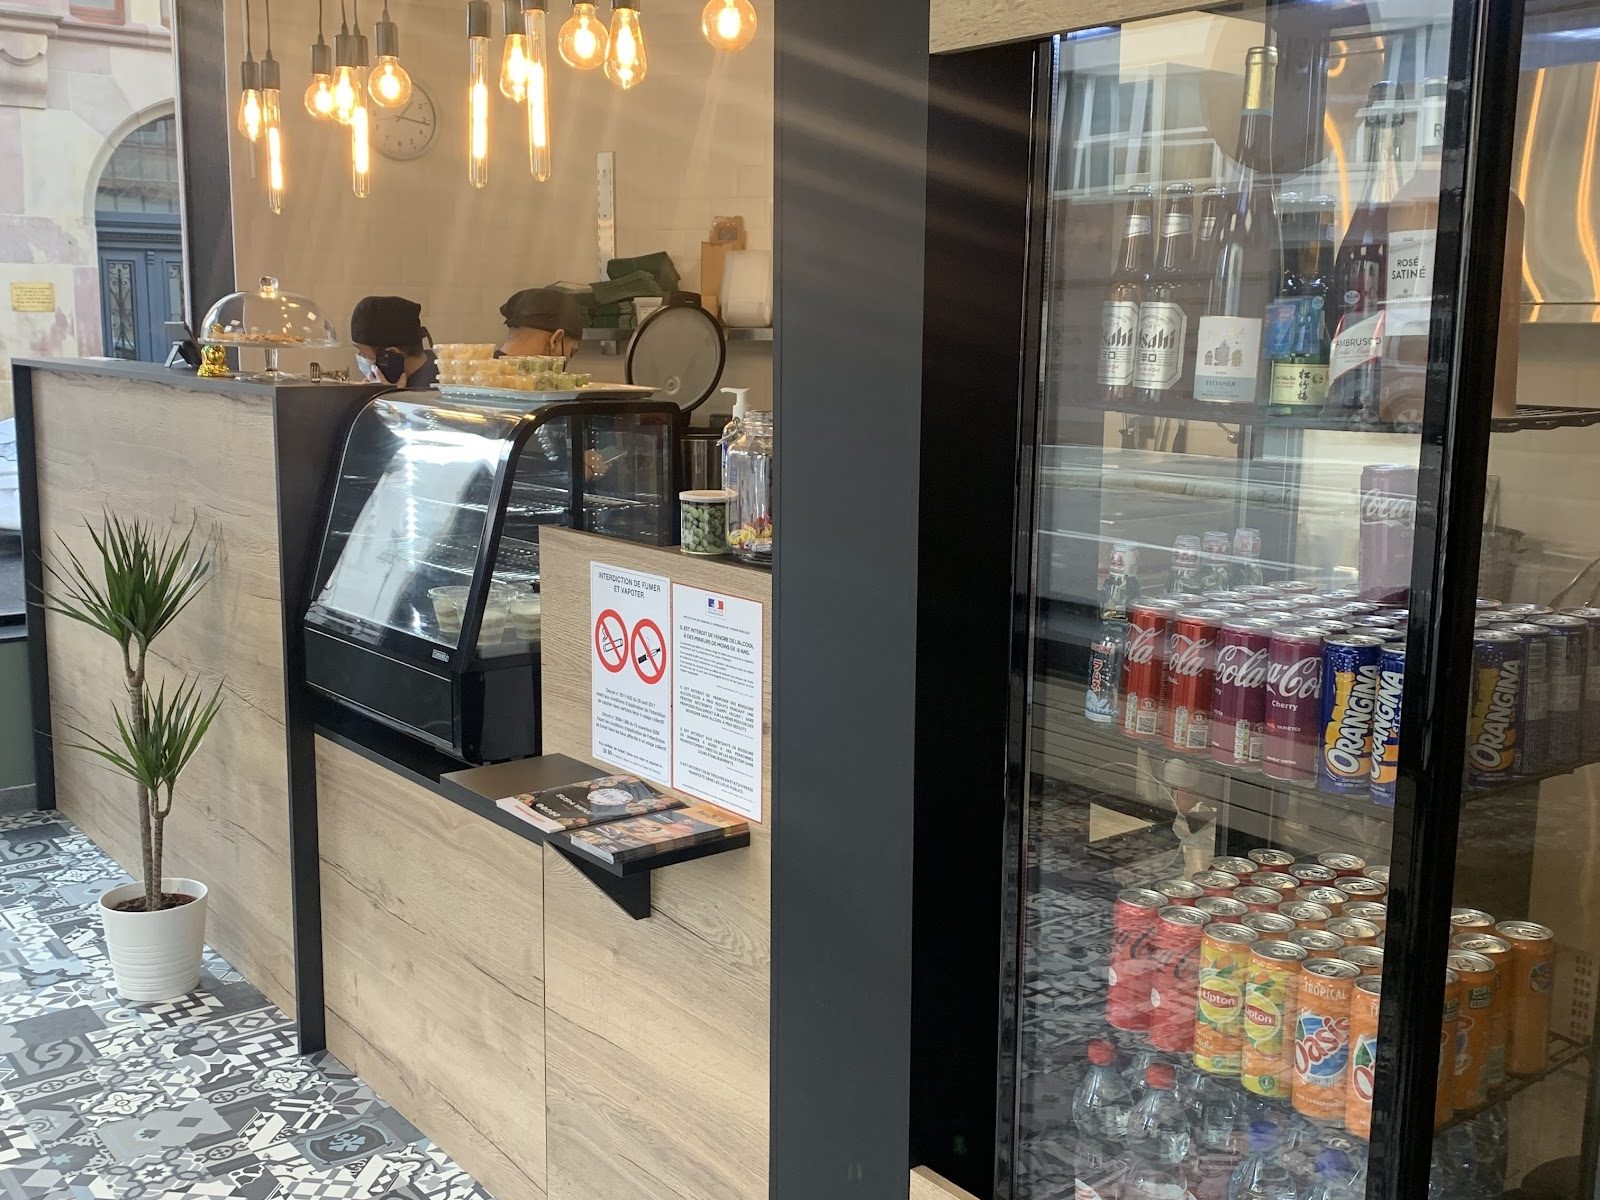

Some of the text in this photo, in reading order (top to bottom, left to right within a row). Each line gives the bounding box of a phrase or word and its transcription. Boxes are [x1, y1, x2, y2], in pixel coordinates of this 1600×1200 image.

[1397, 256, 1418, 267] ROSÉ
[1392, 266, 1426, 280] SATINÉ
[1336, 336, 1382, 348] AMBRUSCO
[599, 572, 661, 592] INTERDICTION DE FUMER
[614, 584, 645, 599] ET VAPOTER
[1272, 700, 1298, 711] Cherry
[1327, 664, 1379, 774] ORANGINA
[1470, 660, 1520, 768] ORANGINA
[1202, 990, 1236, 1005] Lipton
[1304, 981, 1346, 1000] TROPICAL
